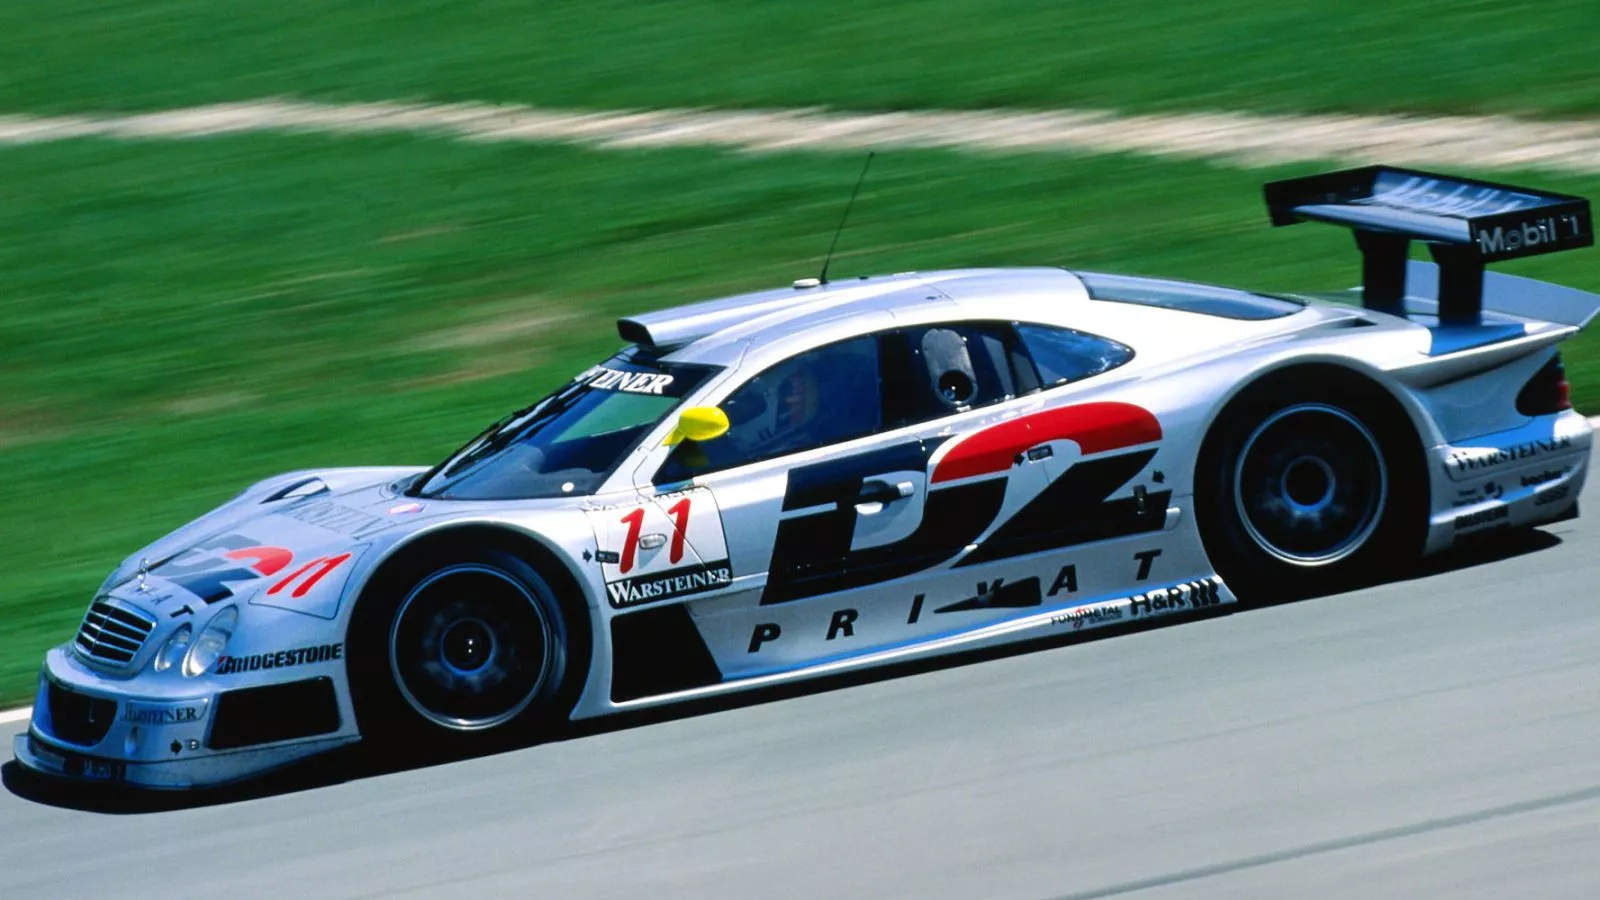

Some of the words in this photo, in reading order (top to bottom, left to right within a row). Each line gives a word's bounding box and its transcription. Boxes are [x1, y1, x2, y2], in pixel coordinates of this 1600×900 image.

[1480, 217, 1557, 254] Mobil
[758, 400, 1173, 606] D2
[620, 497, 692, 574] 11
[266, 552, 352, 599] 11
[606, 566, 731, 605] WARSTEINER
[216, 641, 344, 675] BRIDGESTONE
